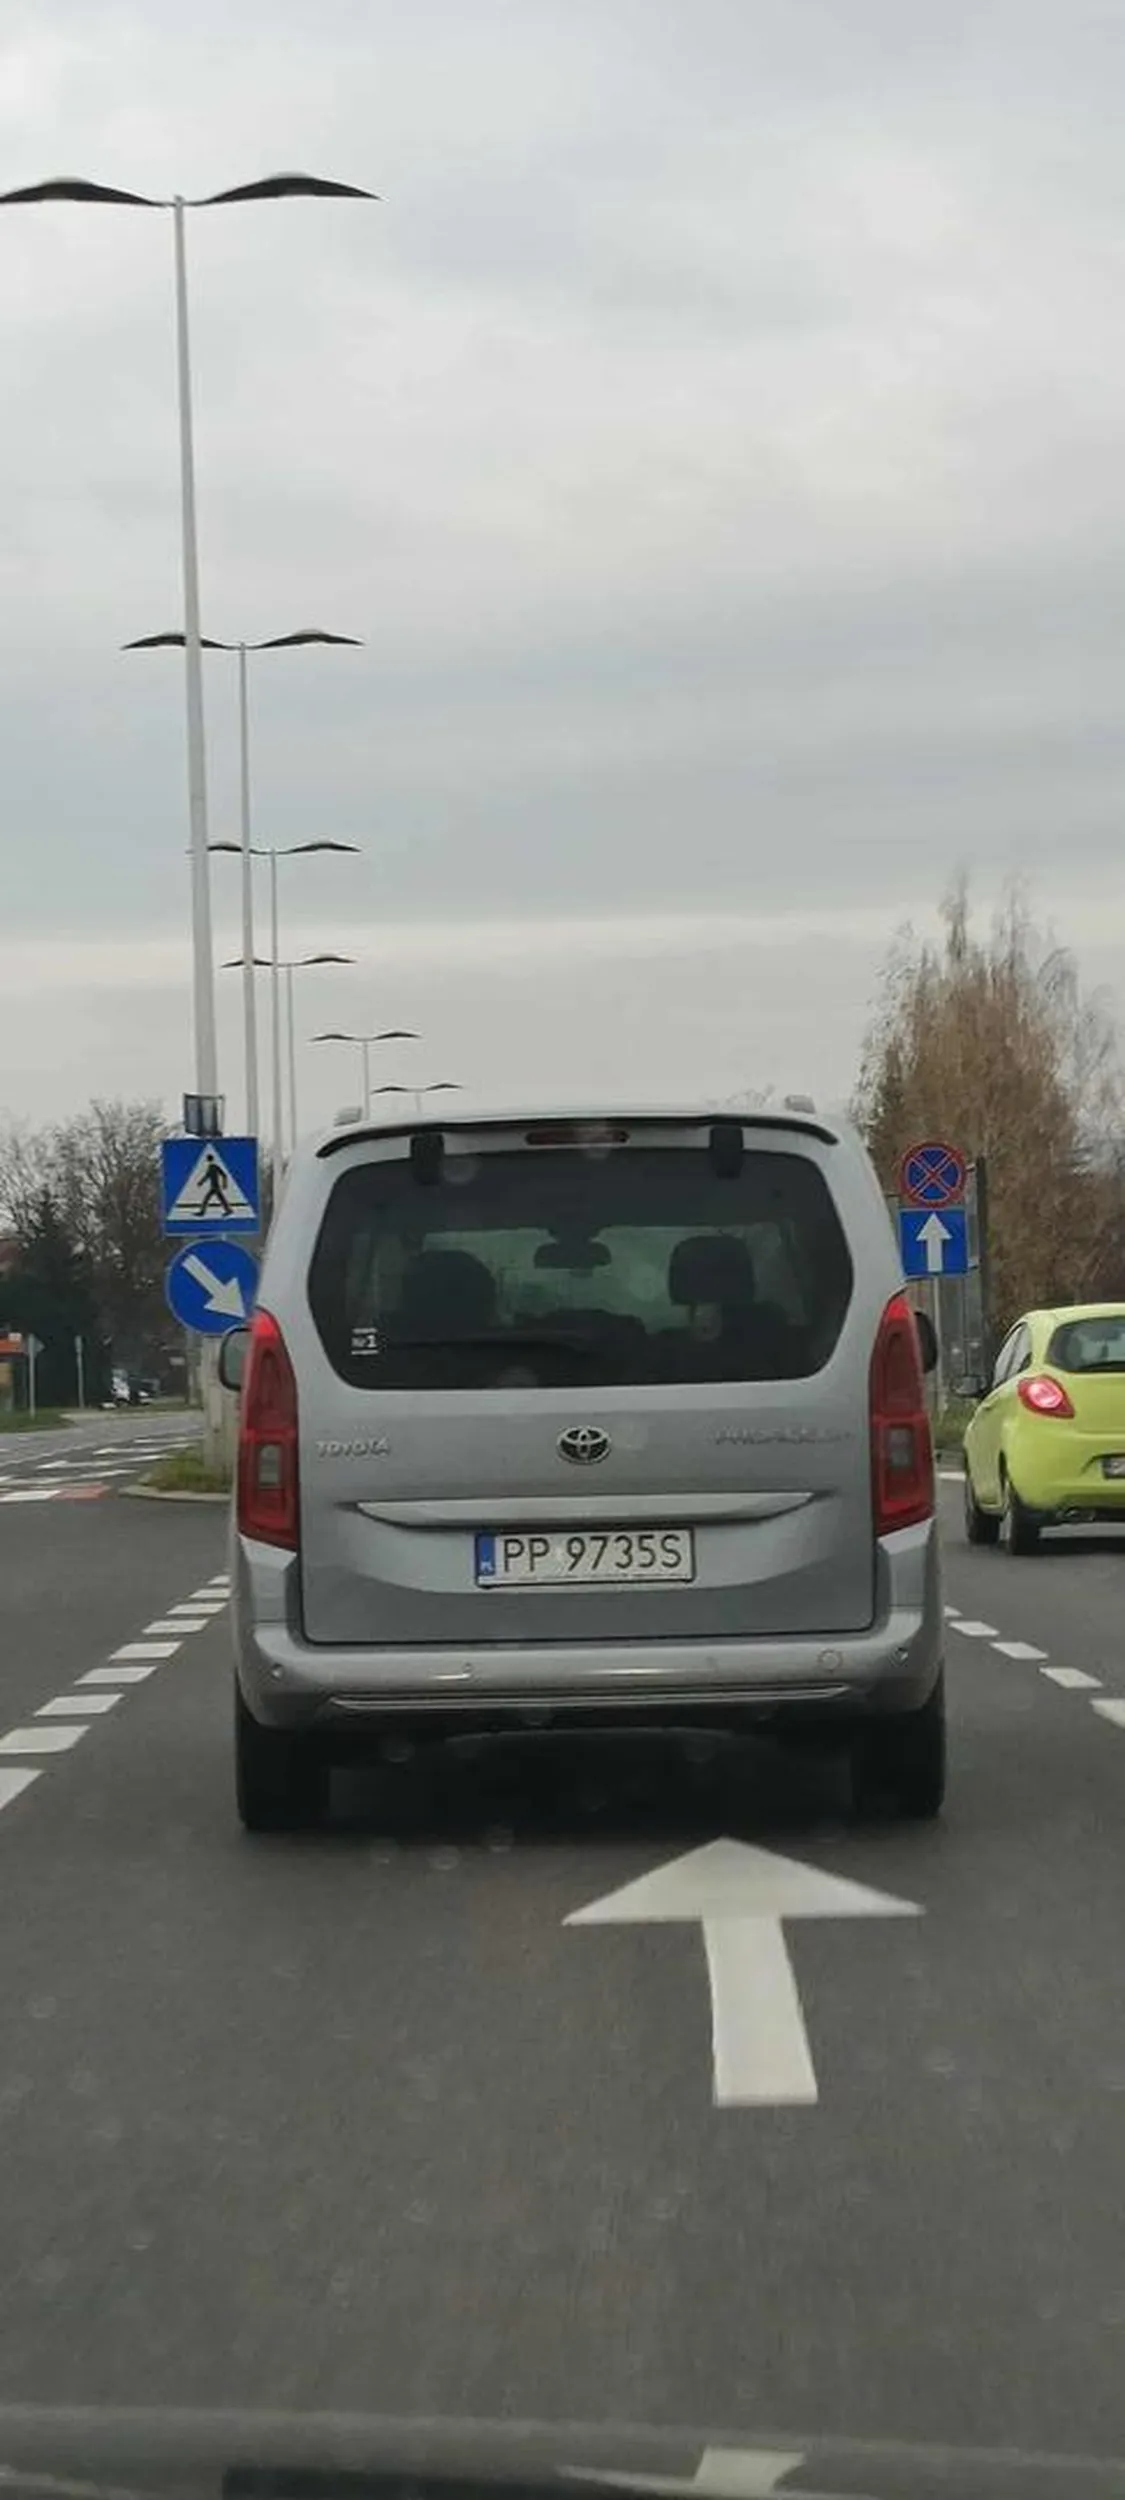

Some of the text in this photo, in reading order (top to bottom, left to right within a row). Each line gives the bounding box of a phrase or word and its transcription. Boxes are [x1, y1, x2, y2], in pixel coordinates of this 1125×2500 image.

[314, 1438, 390, 1460] TOYOTA
[503, 1534, 682, 1572] PP 9735S
